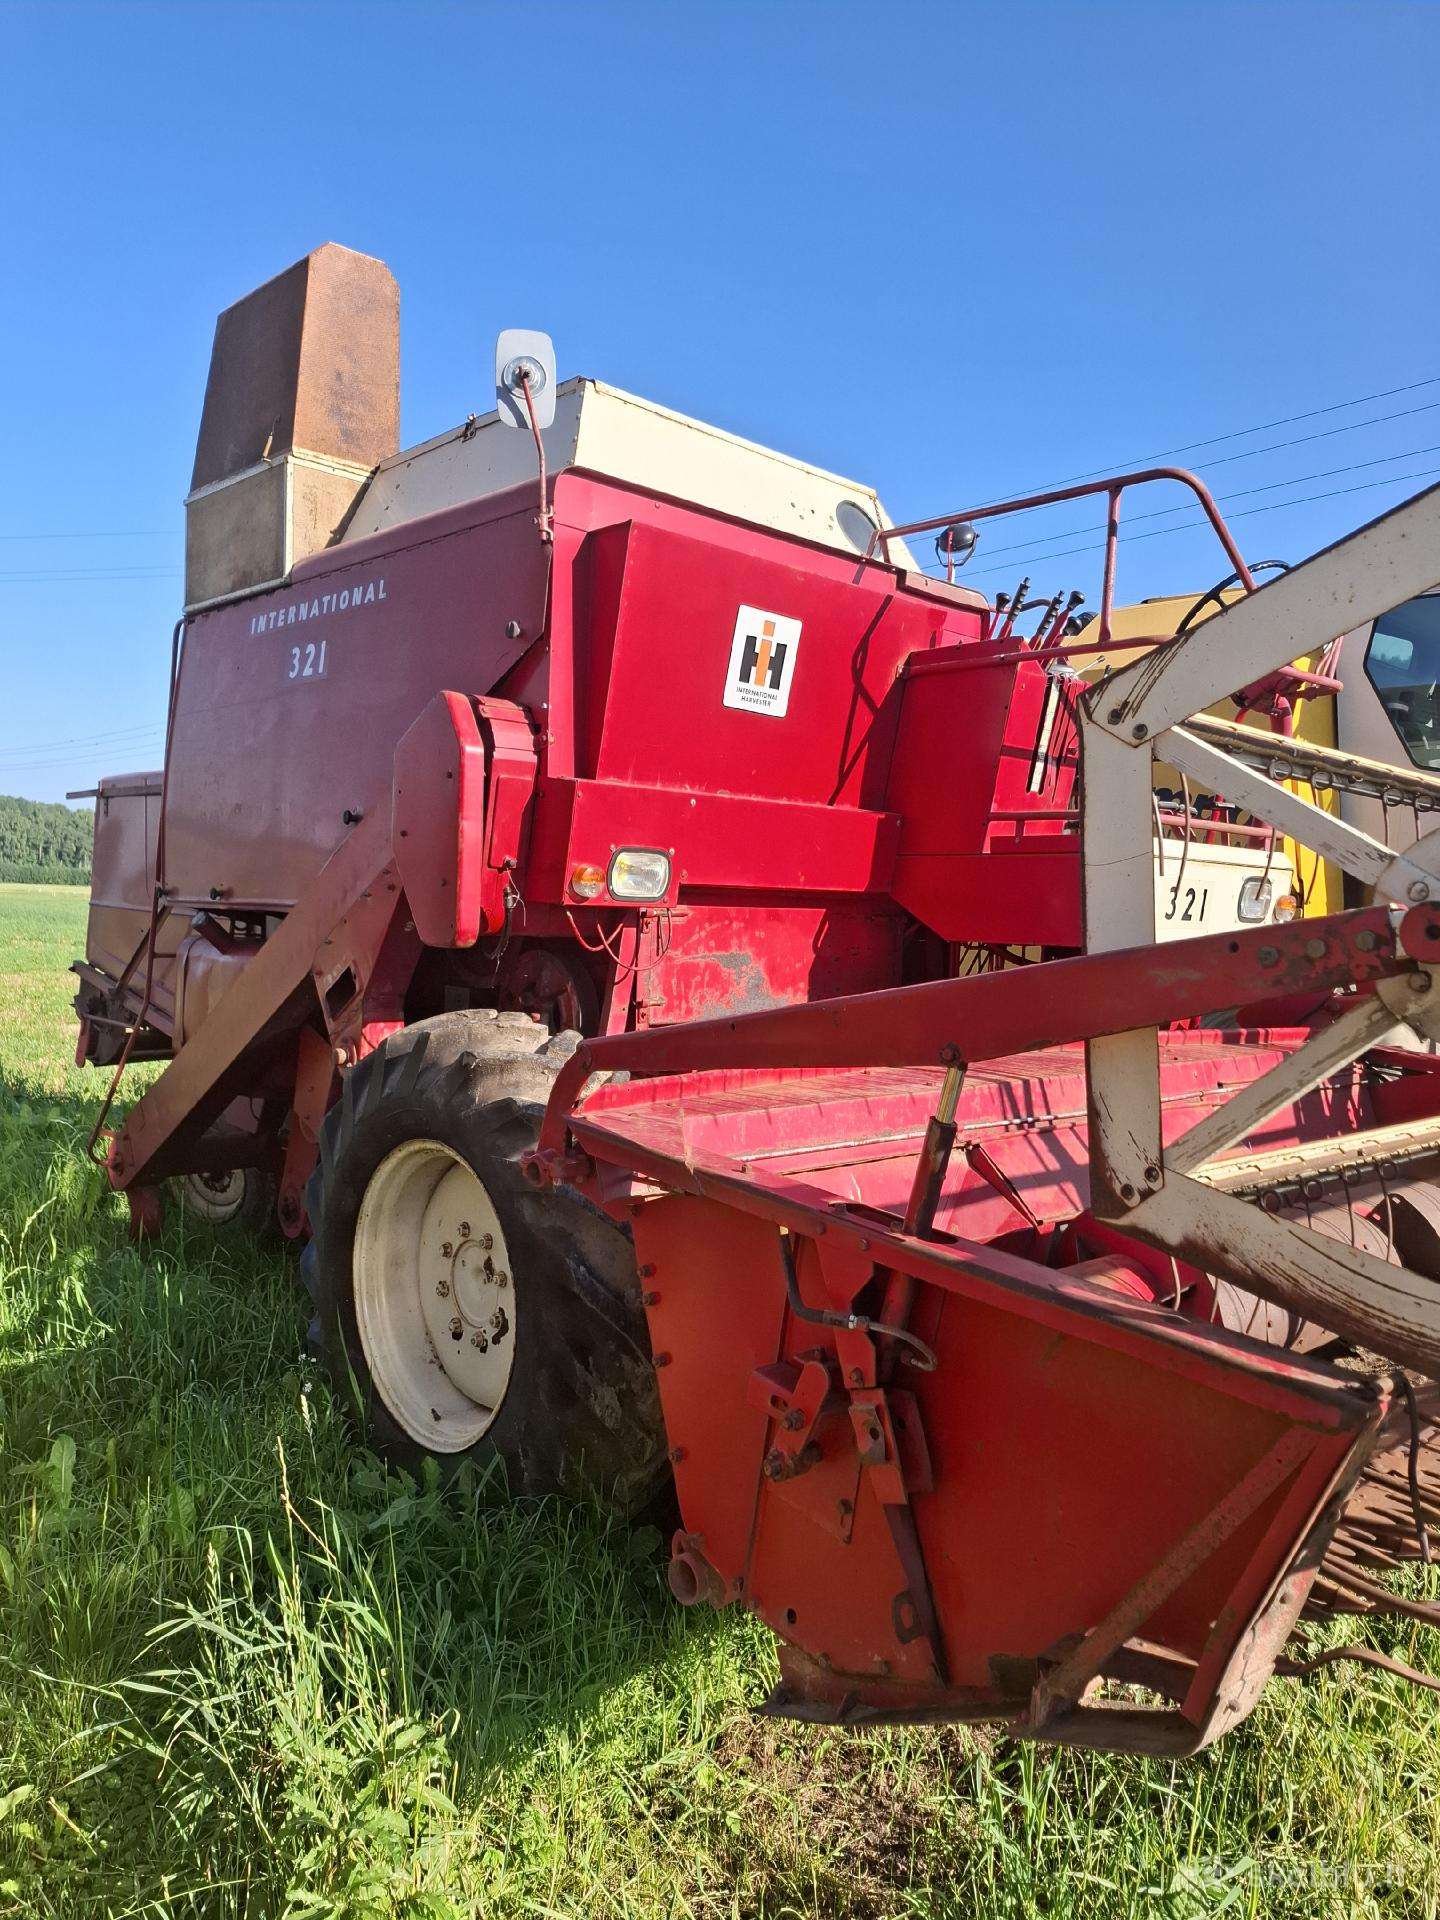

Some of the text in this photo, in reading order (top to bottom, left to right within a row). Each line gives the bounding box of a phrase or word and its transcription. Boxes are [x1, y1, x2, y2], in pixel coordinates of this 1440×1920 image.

[250, 579, 387, 635] INTERNATIONAL
[288, 640, 327, 679] 321
[736, 686, 778, 701] INTERNATIONAL
[740, 695, 772, 707] HARVESTER
[1164, 886, 1208, 922] 321
